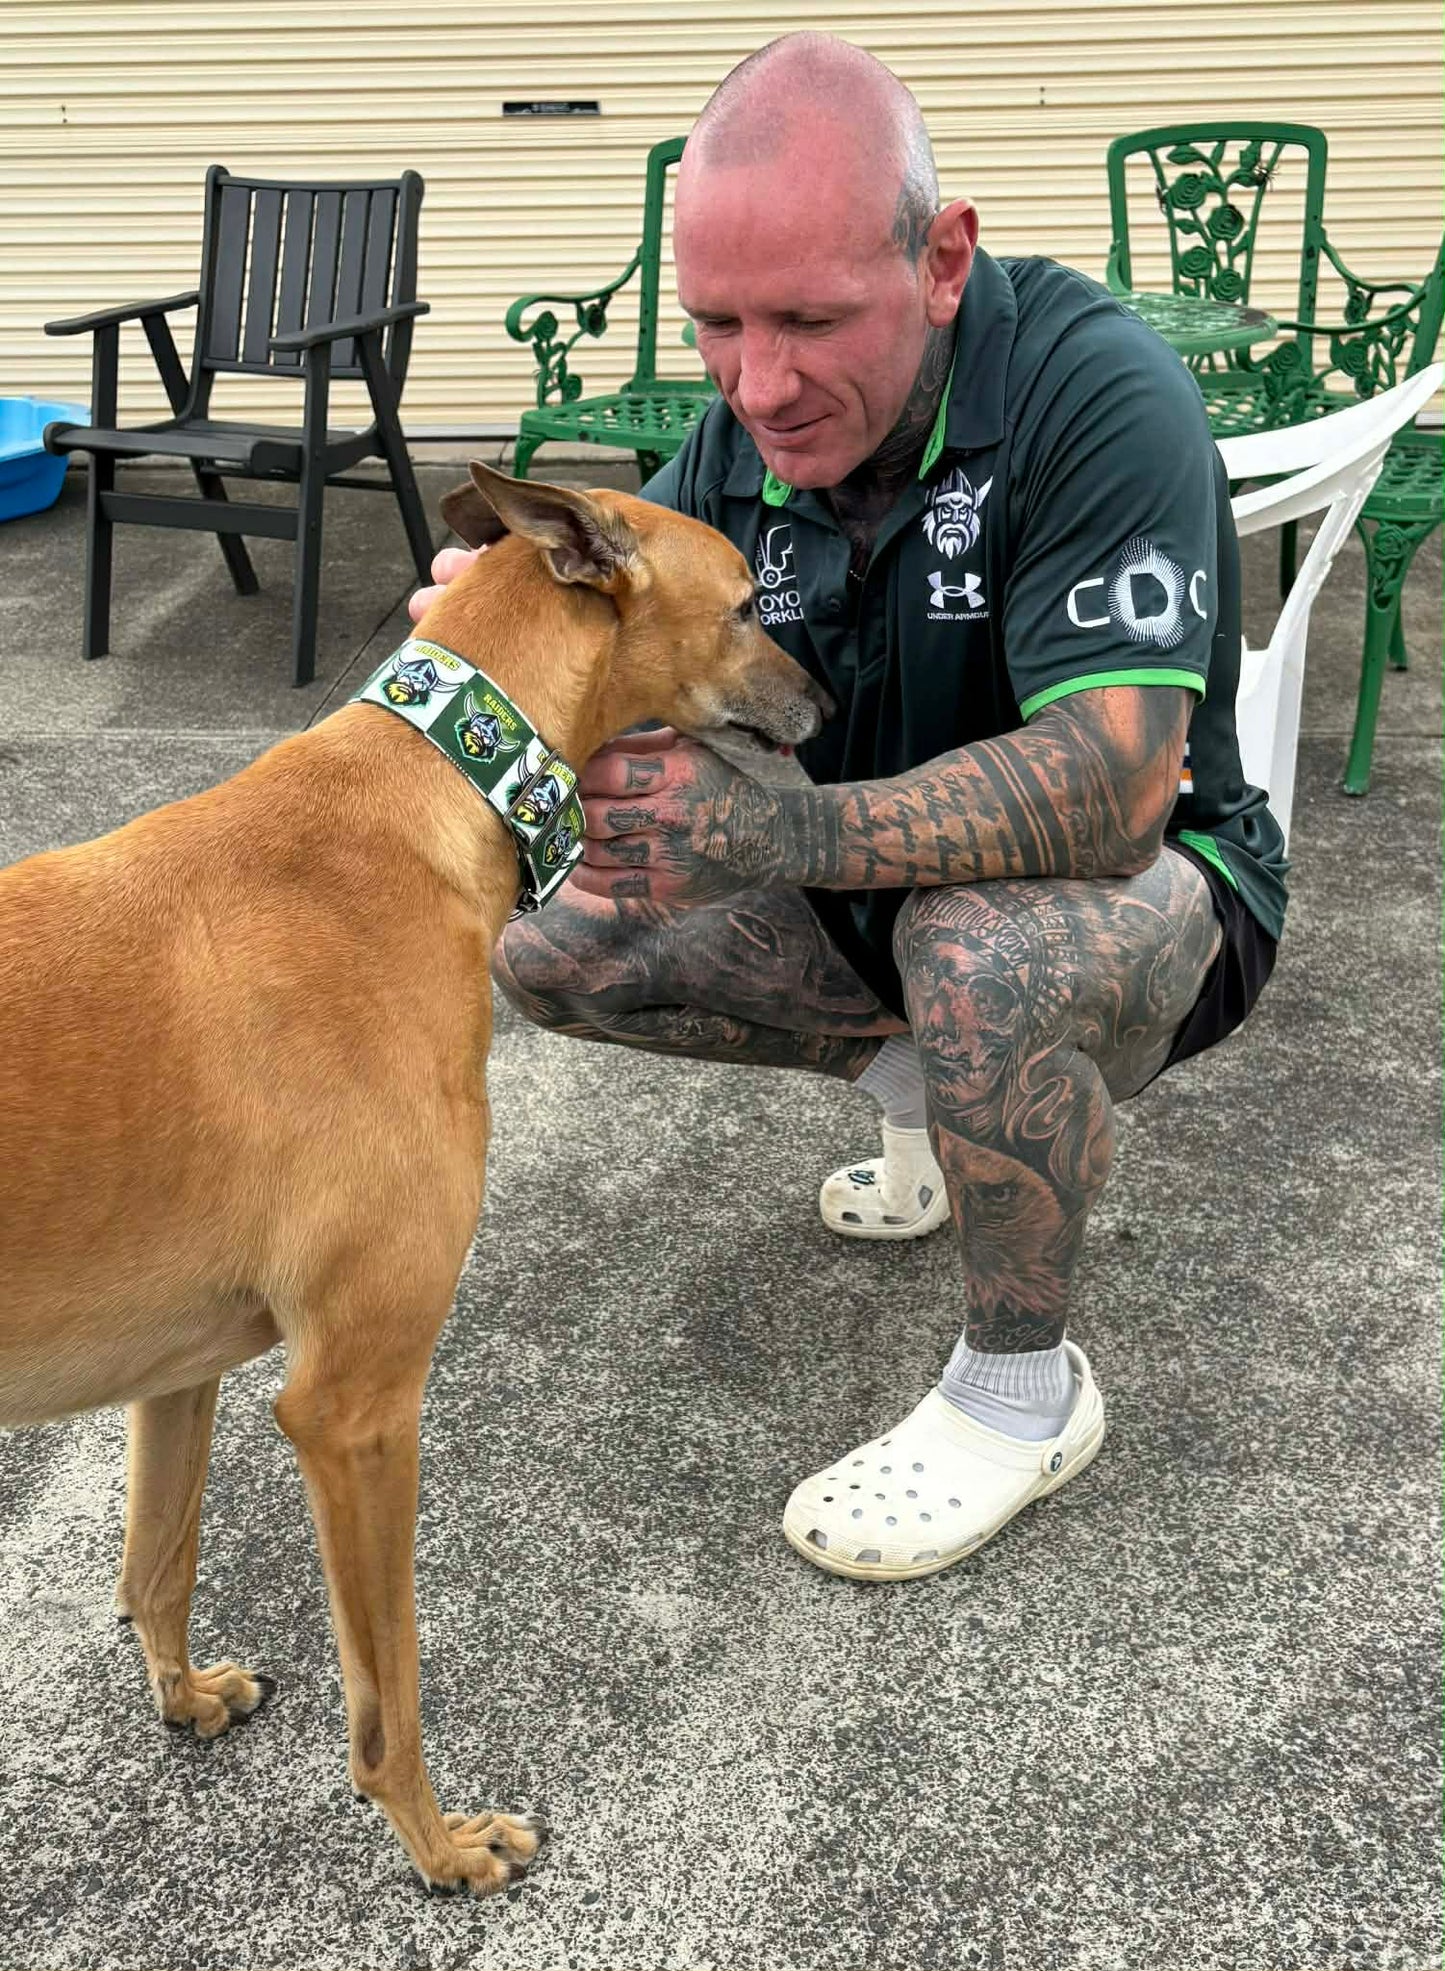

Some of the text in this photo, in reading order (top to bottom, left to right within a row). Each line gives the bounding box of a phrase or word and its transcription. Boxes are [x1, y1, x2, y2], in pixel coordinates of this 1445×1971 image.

[760, 591, 800, 612] OYO
[761, 608, 804, 625] ORKLI
[927, 611, 989, 620] UNDER ARMOUR
[483, 694, 518, 731] RAIDERS
